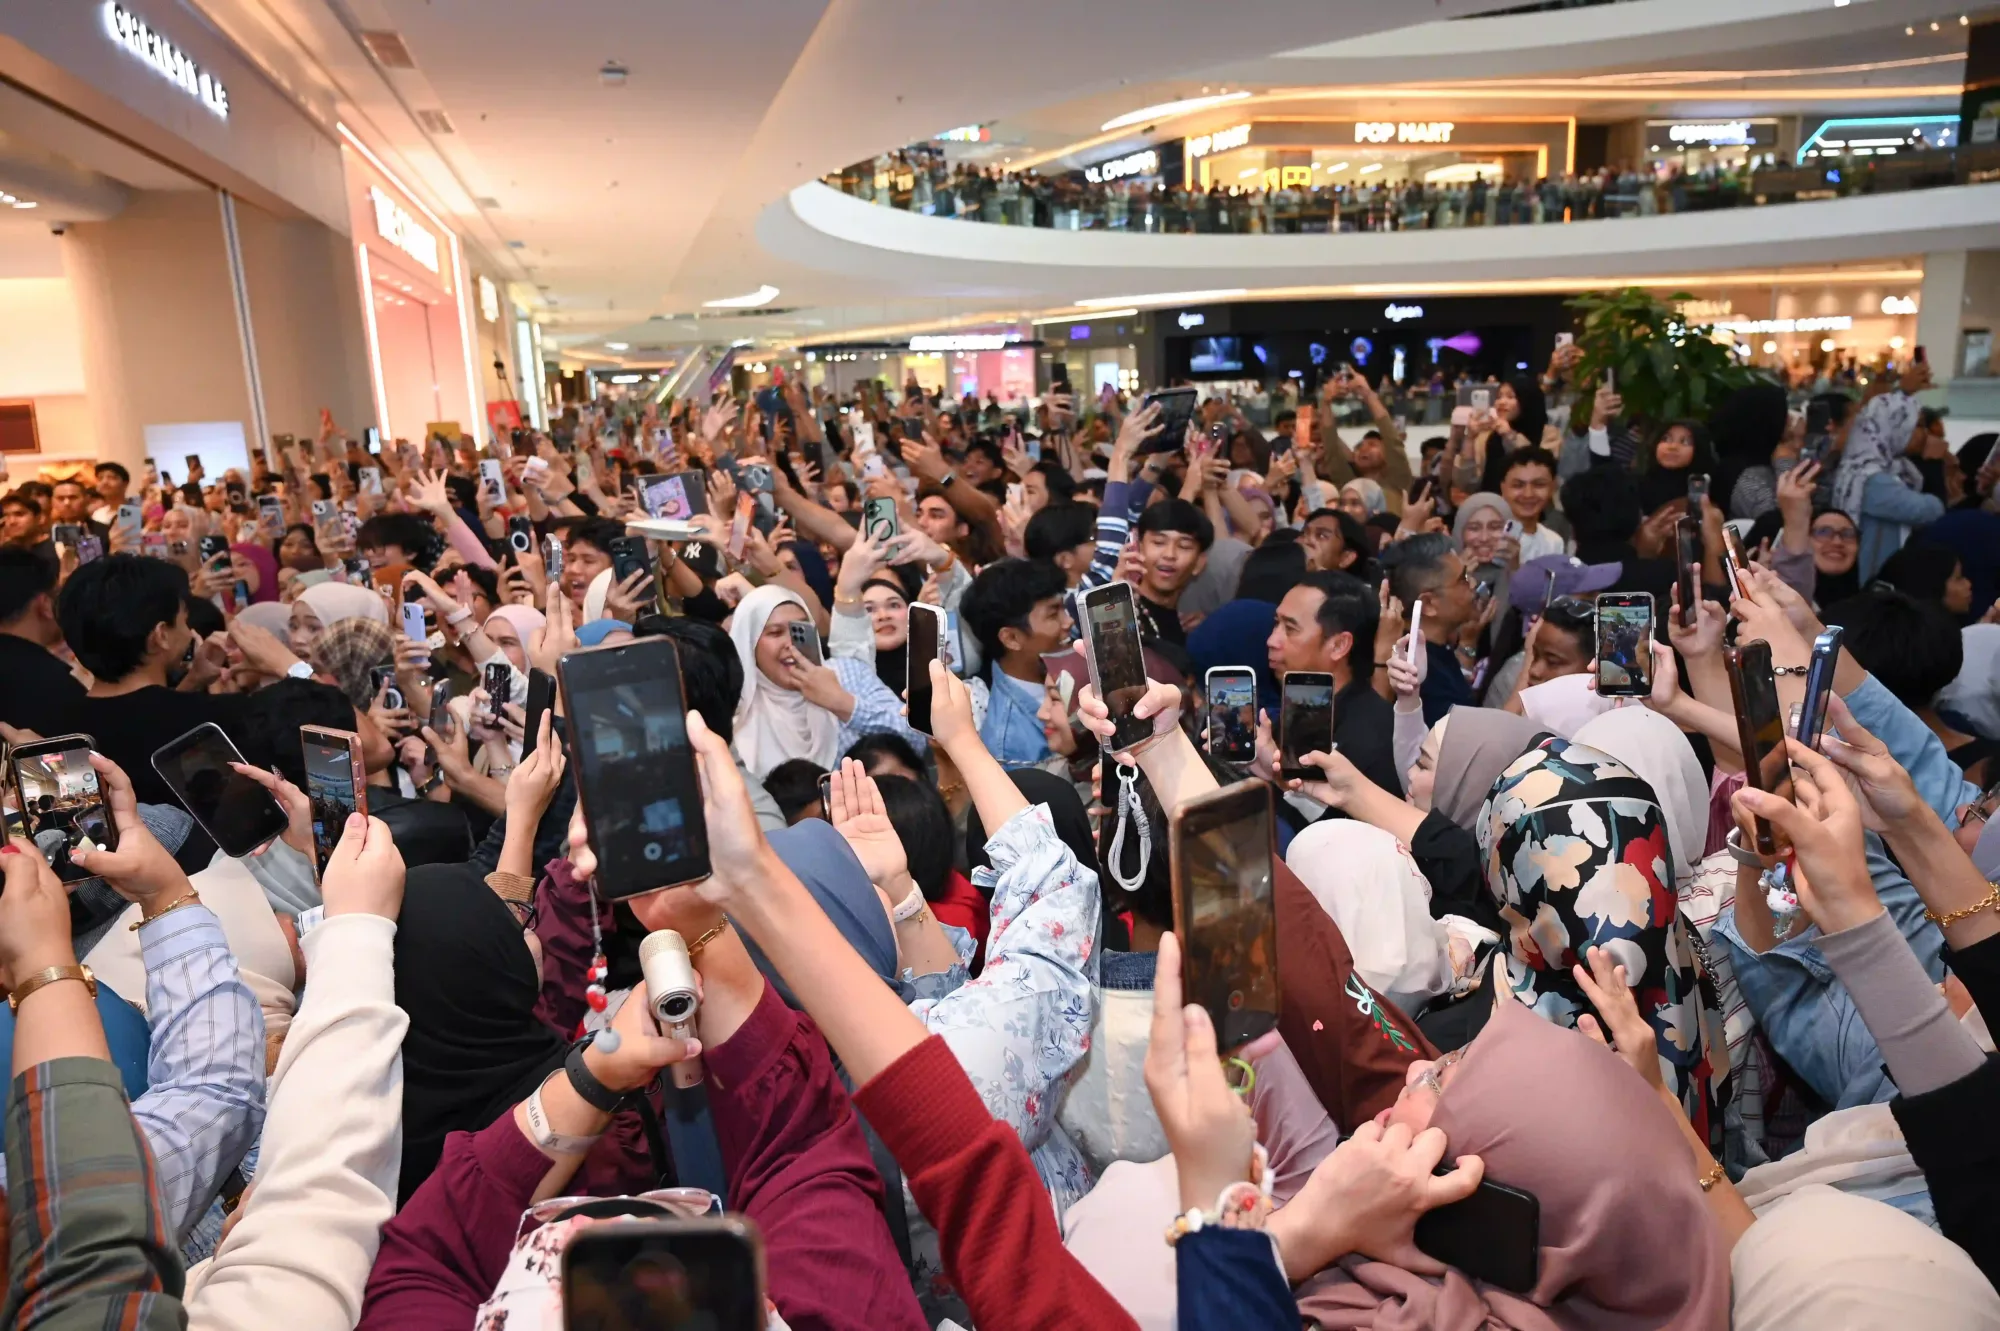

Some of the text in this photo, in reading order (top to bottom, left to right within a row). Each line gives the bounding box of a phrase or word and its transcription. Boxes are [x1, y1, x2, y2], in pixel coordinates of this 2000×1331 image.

[1212, 124, 1252, 152] MART
[1355, 122, 1455, 143] POP MART
[1384, 303, 1424, 322] dyson
